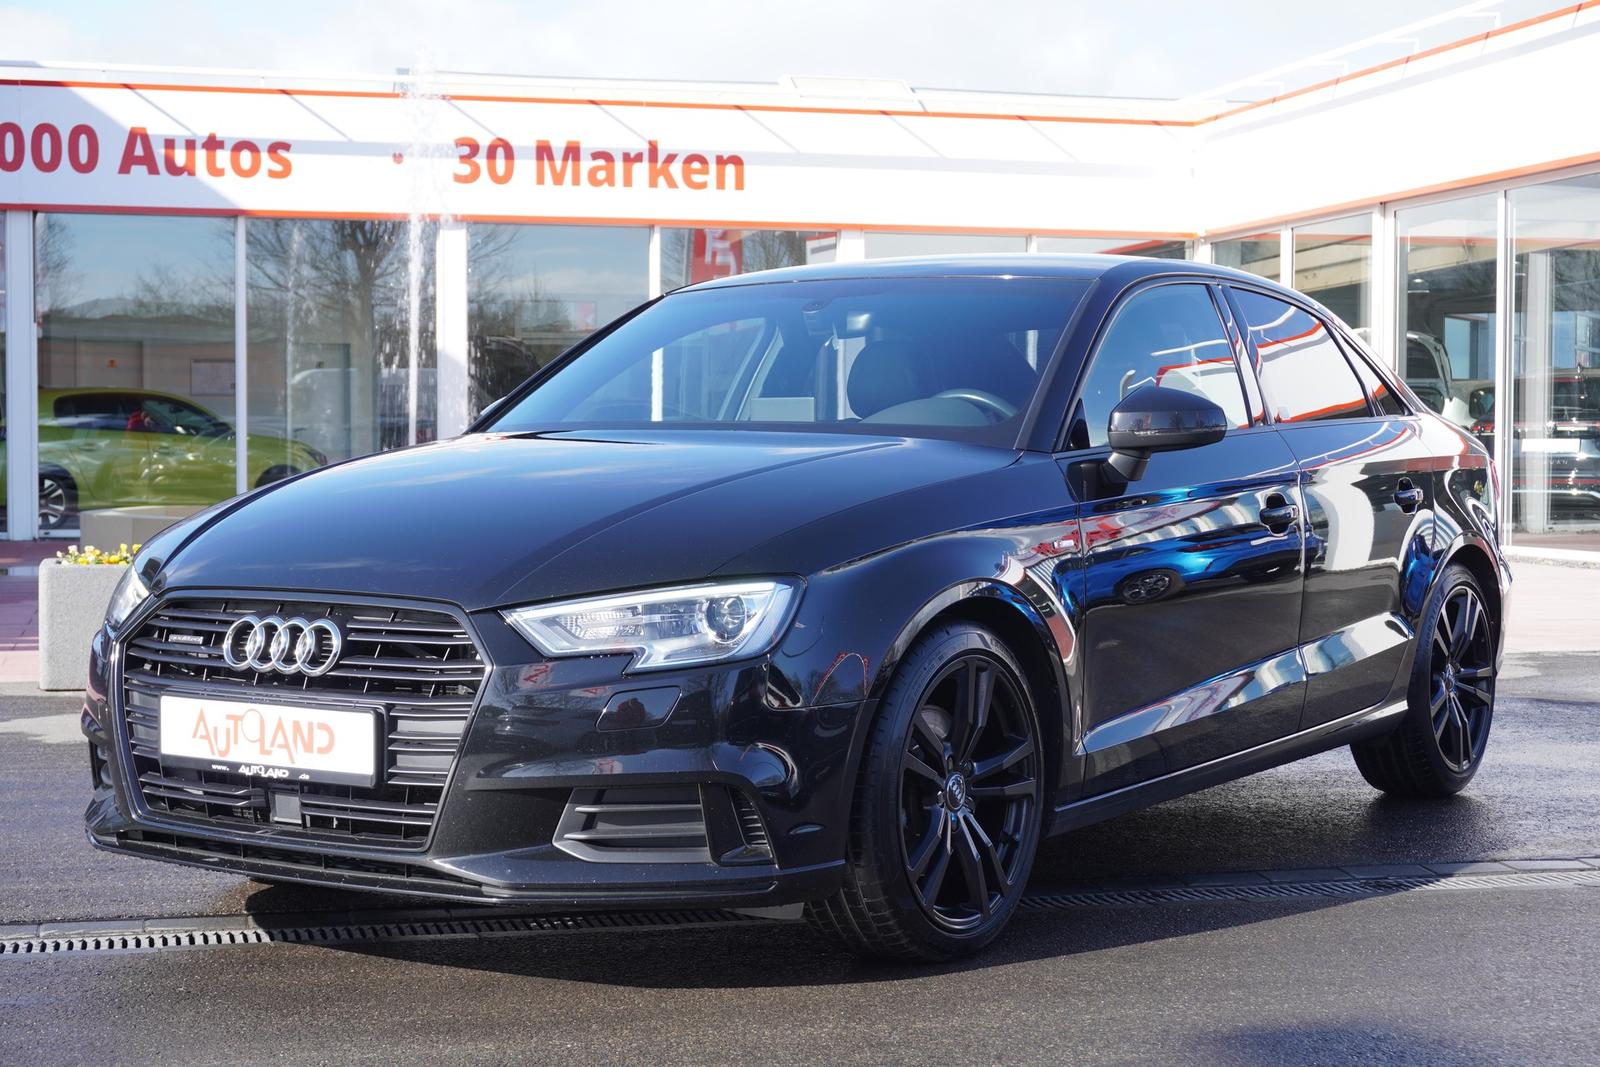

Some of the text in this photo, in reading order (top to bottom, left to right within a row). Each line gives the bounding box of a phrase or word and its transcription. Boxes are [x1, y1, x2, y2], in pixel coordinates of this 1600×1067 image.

[0, 122, 293, 179] 000 Autos
[453, 137, 745, 191] 30 Marken
[192, 707, 335, 764] AUTOLAND
[238, 764, 289, 778] AUTOLAND
